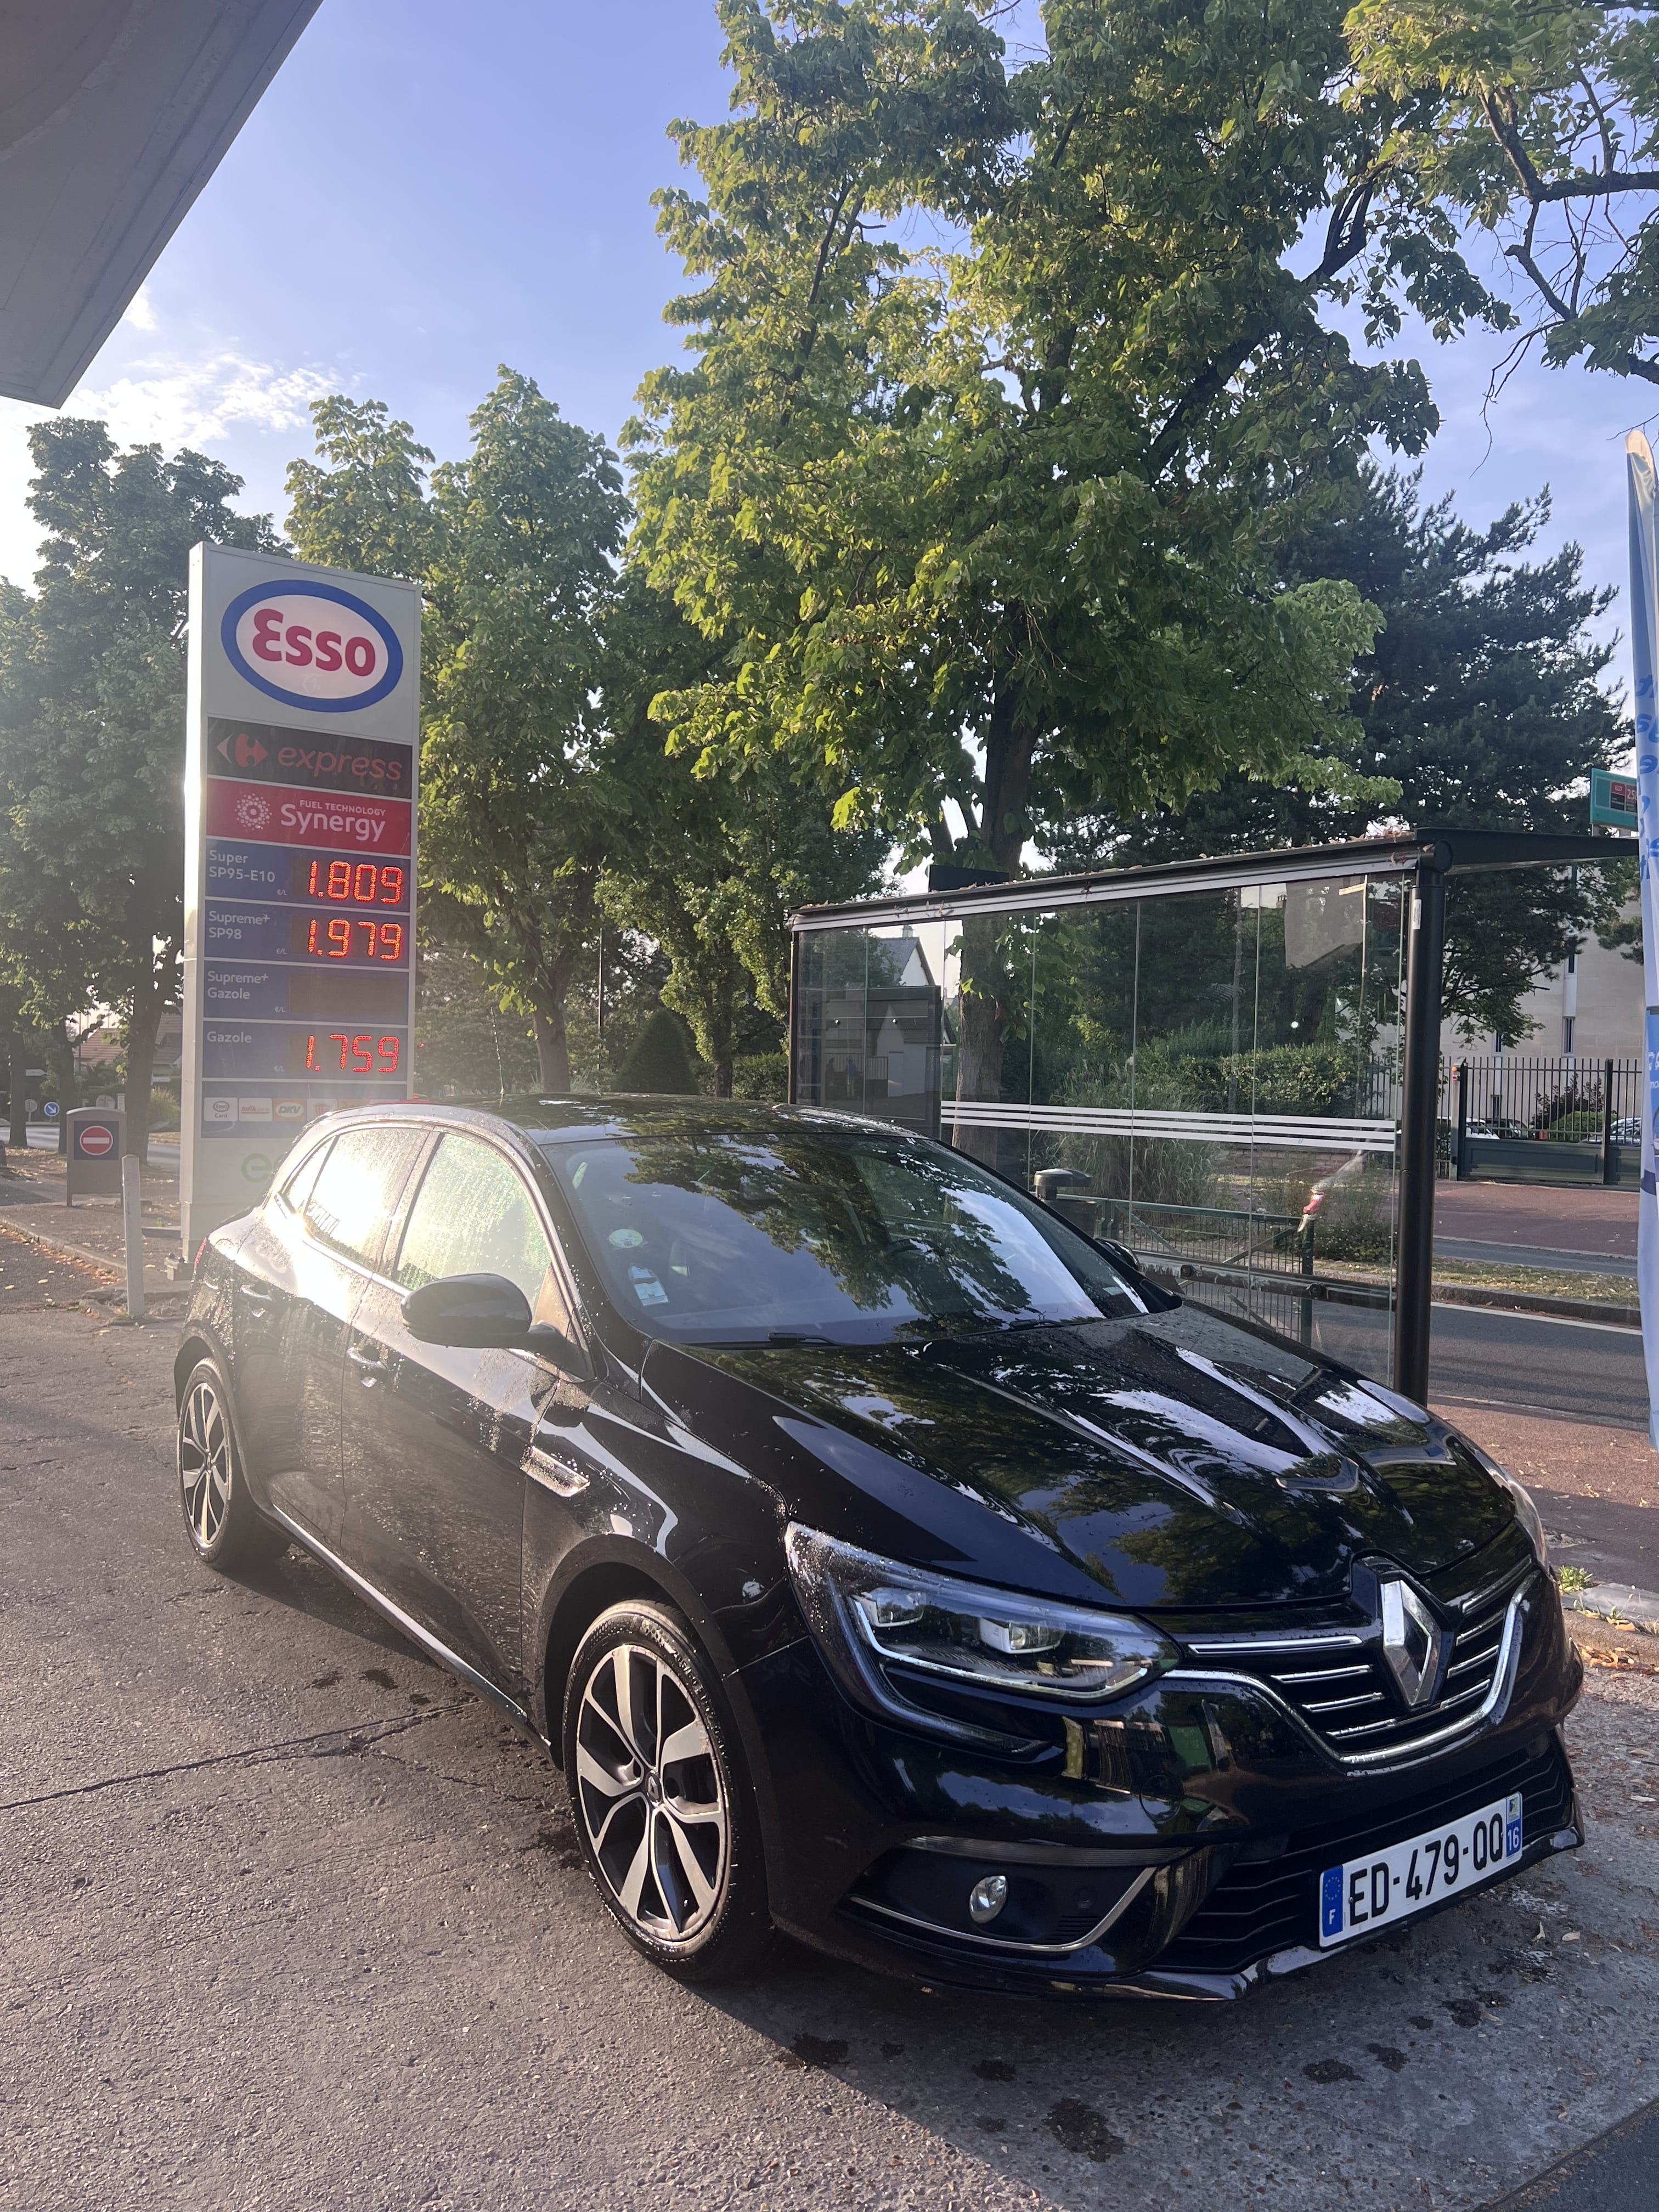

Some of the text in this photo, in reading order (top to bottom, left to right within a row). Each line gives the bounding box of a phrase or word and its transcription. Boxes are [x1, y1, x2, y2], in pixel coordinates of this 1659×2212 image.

[252, 608, 376, 676] Esso
[278, 746, 403, 781] express
[300, 799, 386, 816] FUEL TECHNOLOGY
[280, 804, 386, 842] Synergy
[209, 850, 249, 865] Super
[209, 866, 275, 883] SP95-E10
[309, 861, 403, 904] 1.809
[208, 910, 270, 926] Supreme+
[208, 927, 242, 940] SP98
[308, 919, 402, 960] 1.979
[207, 970, 269, 985] Supreme+
[207, 987, 251, 1000] Gazole
[207, 1031, 252, 1043] Gazole
[306, 1034, 399, 1073] 1.759
[1508, 1826, 1519, 1851] 16
[1350, 1813, 1503, 1926] ED-479-QQ
[1329, 1909, 1336, 1925] F
